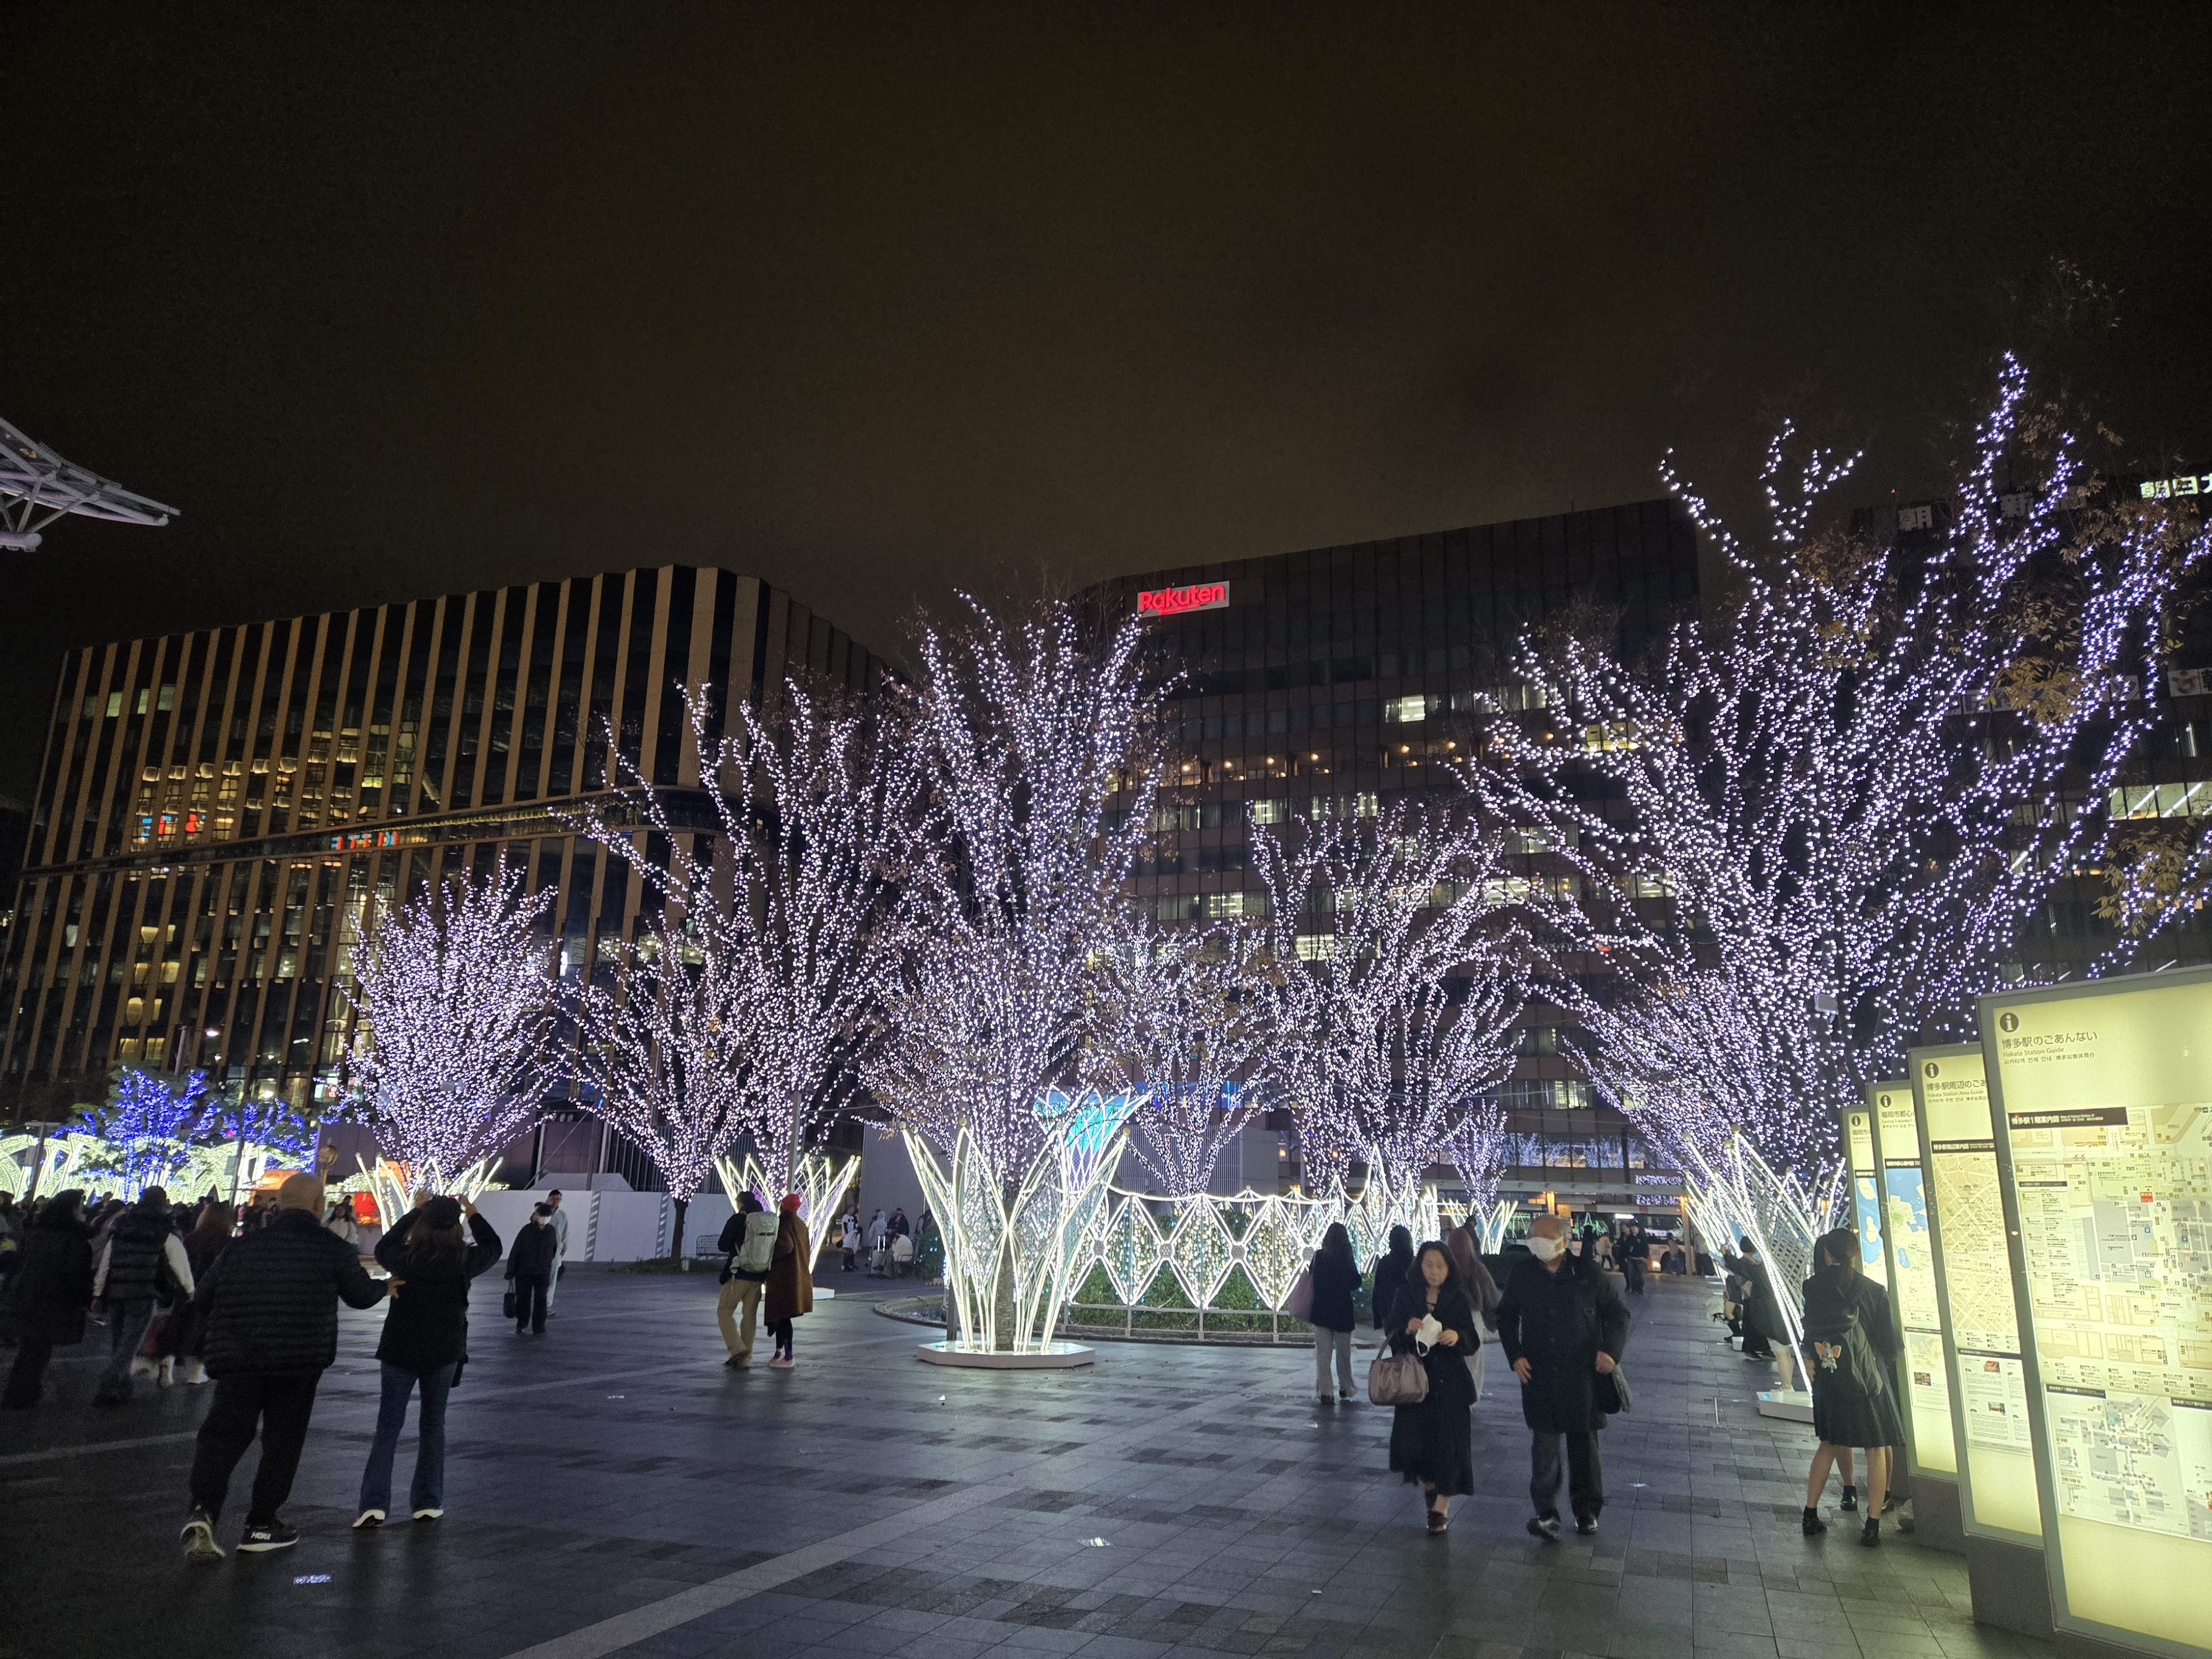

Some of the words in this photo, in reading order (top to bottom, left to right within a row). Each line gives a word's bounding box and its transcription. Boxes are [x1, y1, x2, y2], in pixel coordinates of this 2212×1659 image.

[1140, 585, 1225, 612] Rakuten
[2002, 1031, 2098, 1050] 博多駅のごあんない
